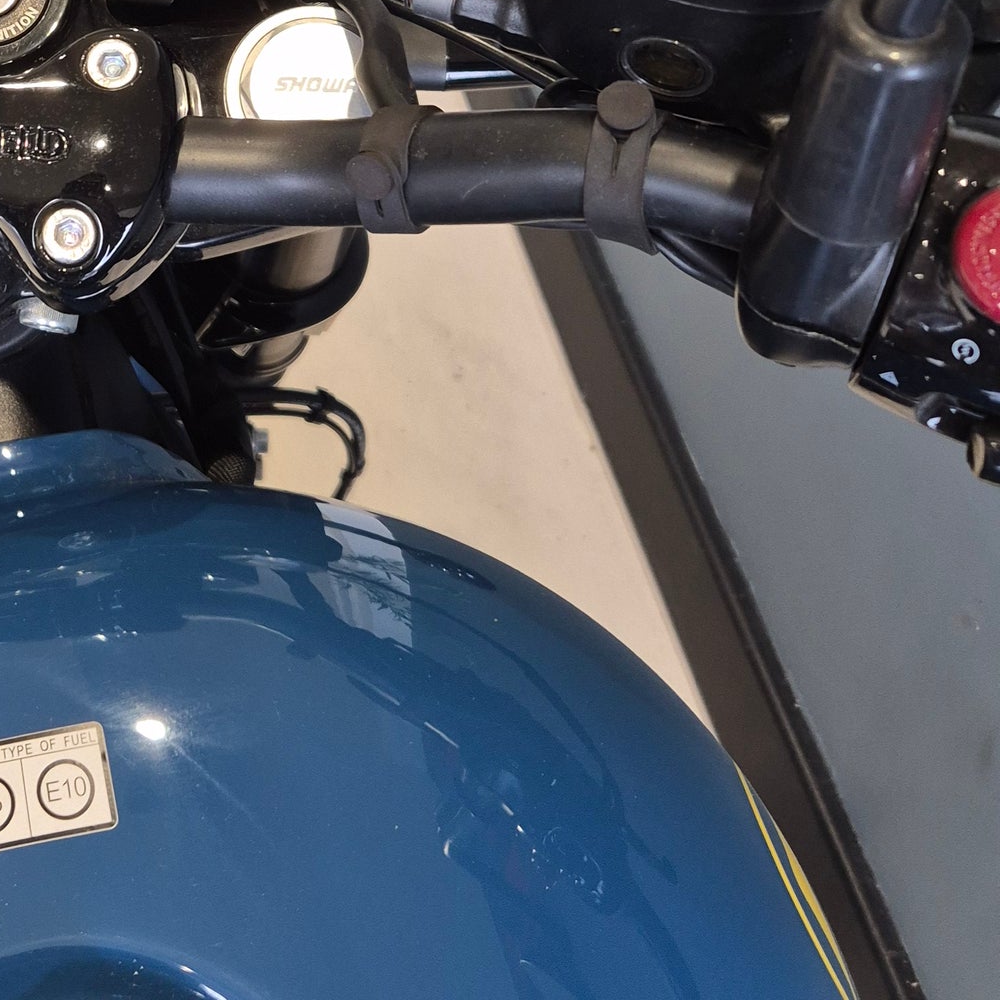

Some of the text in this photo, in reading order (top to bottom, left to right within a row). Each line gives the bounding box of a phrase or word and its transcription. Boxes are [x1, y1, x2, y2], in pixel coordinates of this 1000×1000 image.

[1, 743, 33, 760] TYPE
[40, 738, 56, 752] OF
[64, 730, 96, 748] FUEL
[46, 776, 87, 803] E10
